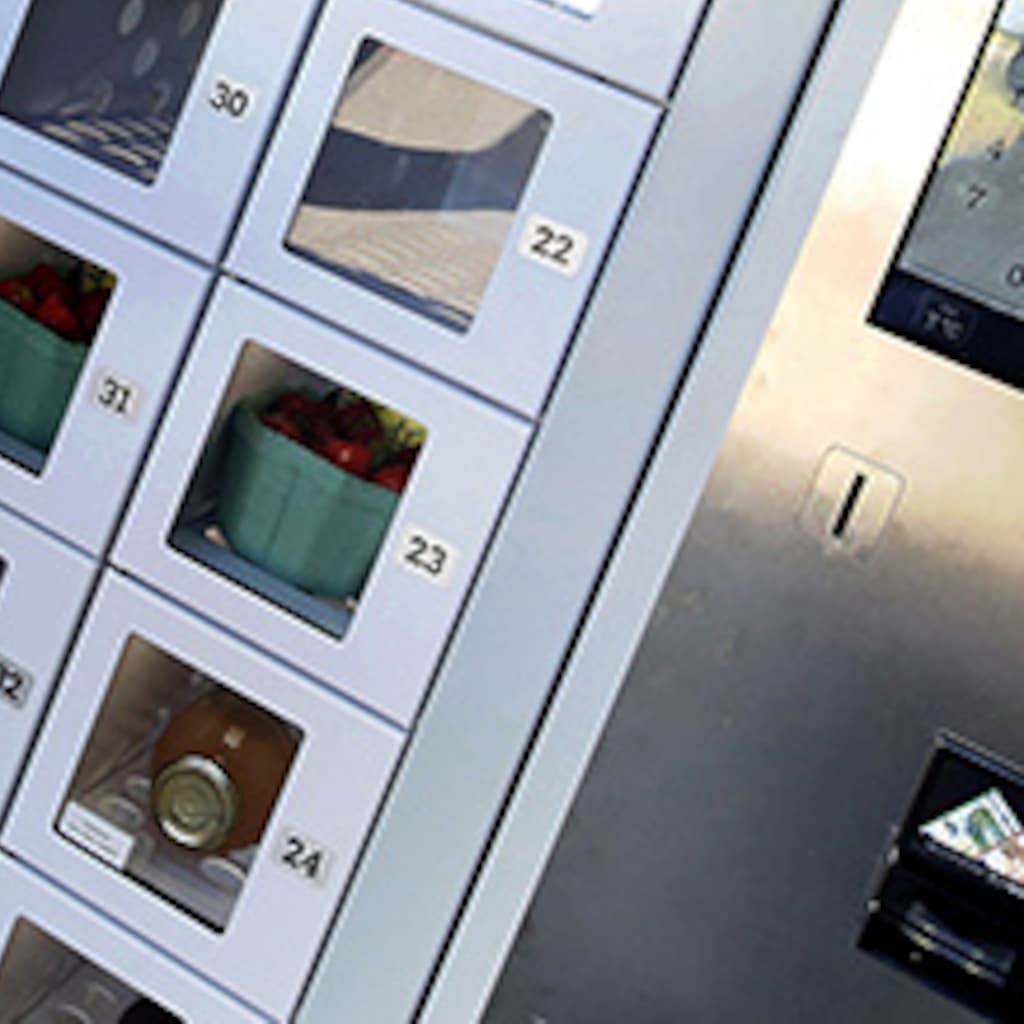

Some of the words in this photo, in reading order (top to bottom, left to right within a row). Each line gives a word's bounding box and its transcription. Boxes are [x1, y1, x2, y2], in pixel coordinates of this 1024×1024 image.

[209, 80, 248, 117] 30
[532, 226, 574, 265] 22
[98, 376, 132, 414] 31
[405, 536, 447, 577] 23
[282, 837, 323, 878] 24
